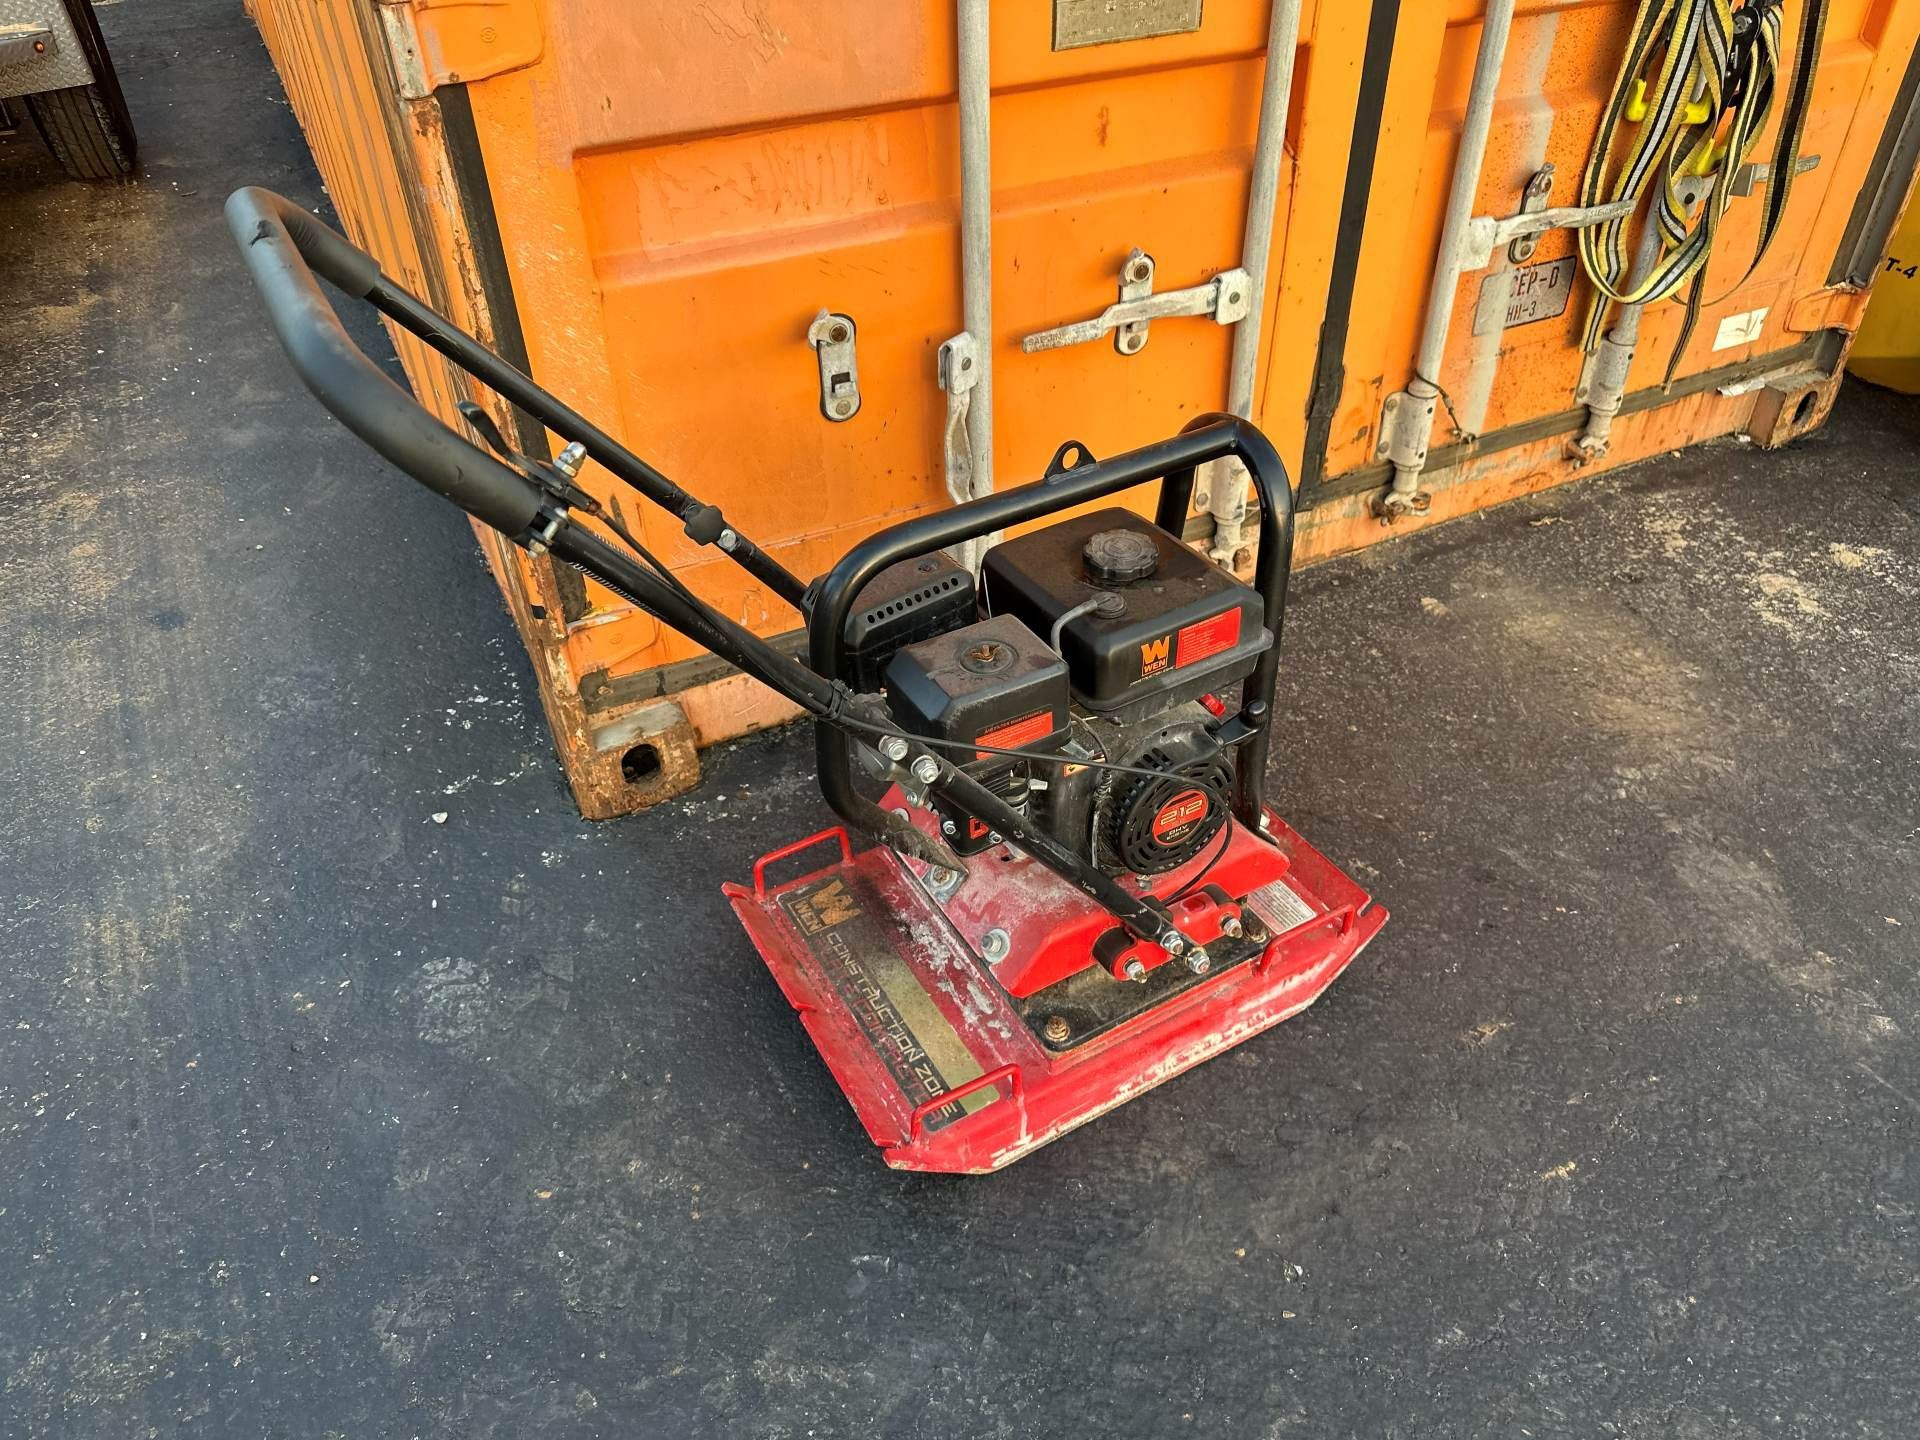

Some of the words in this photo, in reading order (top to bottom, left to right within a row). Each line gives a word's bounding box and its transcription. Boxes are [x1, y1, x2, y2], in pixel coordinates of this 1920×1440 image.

[1885, 257, 1918, 279] T-4
[1143, 658, 1166, 674] WEN
[1160, 799, 1203, 825] 212
[794, 899, 821, 932] WEN
[826, 931, 924, 1062] CONSTRUCTION
